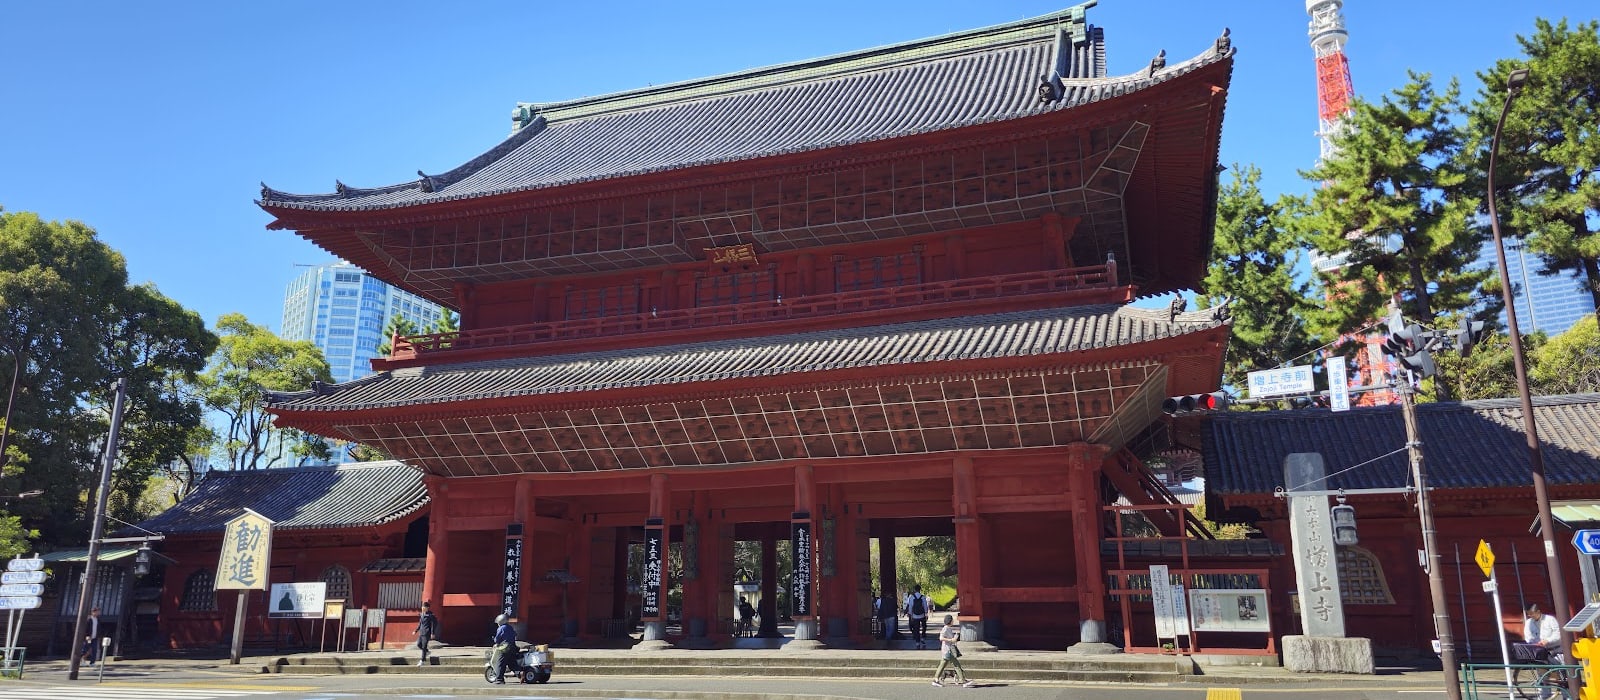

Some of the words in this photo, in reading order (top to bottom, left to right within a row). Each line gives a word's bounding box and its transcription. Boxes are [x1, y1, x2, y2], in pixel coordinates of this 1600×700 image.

[1254, 370, 1306, 386] 増上寺前
[1280, 383, 1303, 391] Temple
[1590, 537, 1600, 546] 40
[229, 520, 261, 586] 勧進
